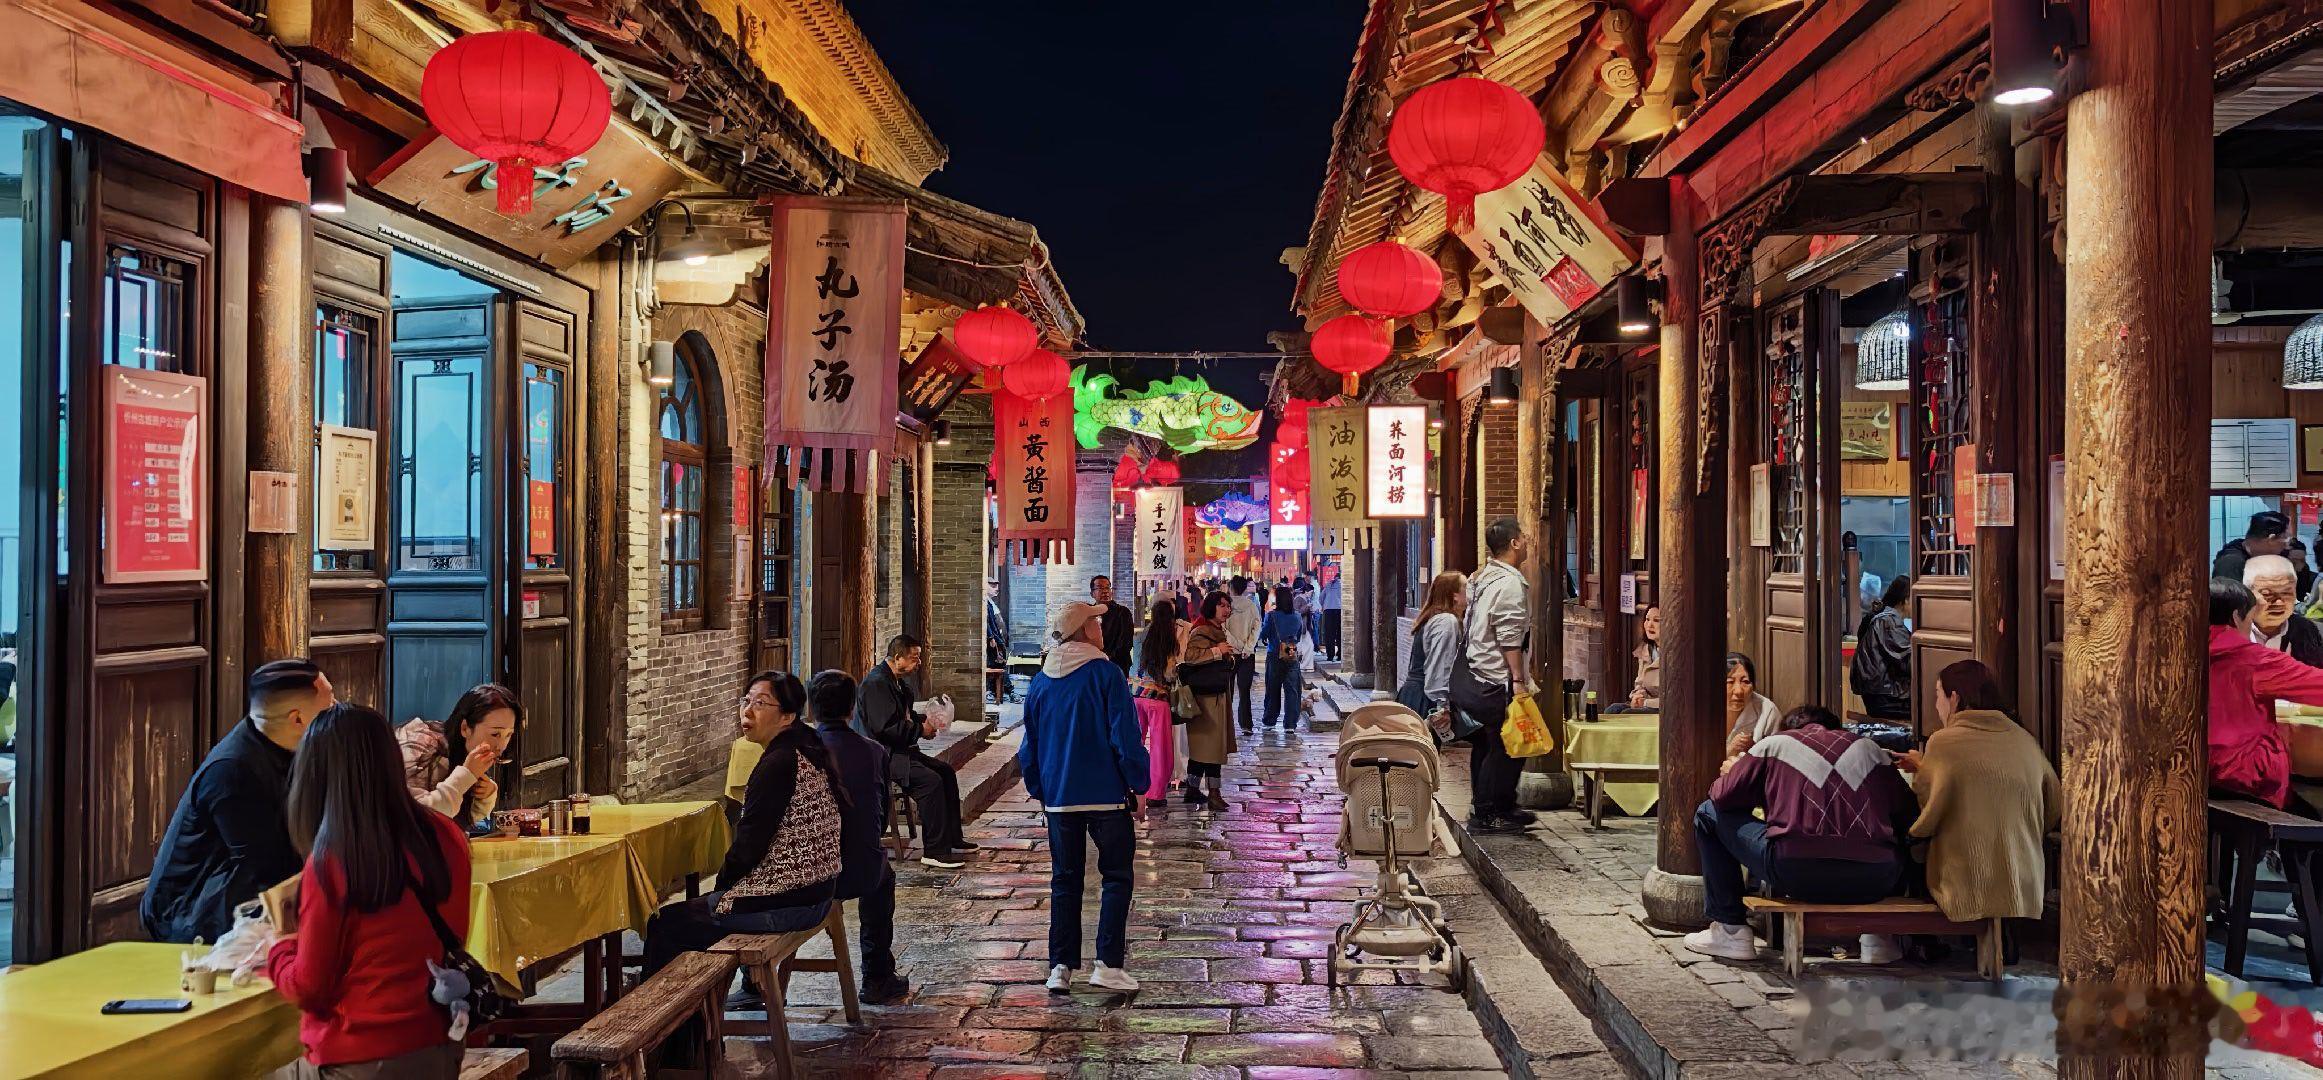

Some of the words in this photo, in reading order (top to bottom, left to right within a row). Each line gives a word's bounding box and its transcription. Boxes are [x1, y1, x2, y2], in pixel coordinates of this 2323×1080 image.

[808, 256, 860, 404] 丸子汤
[1018, 416, 1051, 428] 山西
[1387, 419, 1407, 504] 荞面河捞
[1841, 428, 1881, 441] 色小吃
[1022, 433, 1049, 523] 黄酱面
[1329, 420, 1357, 512] 油泼面
